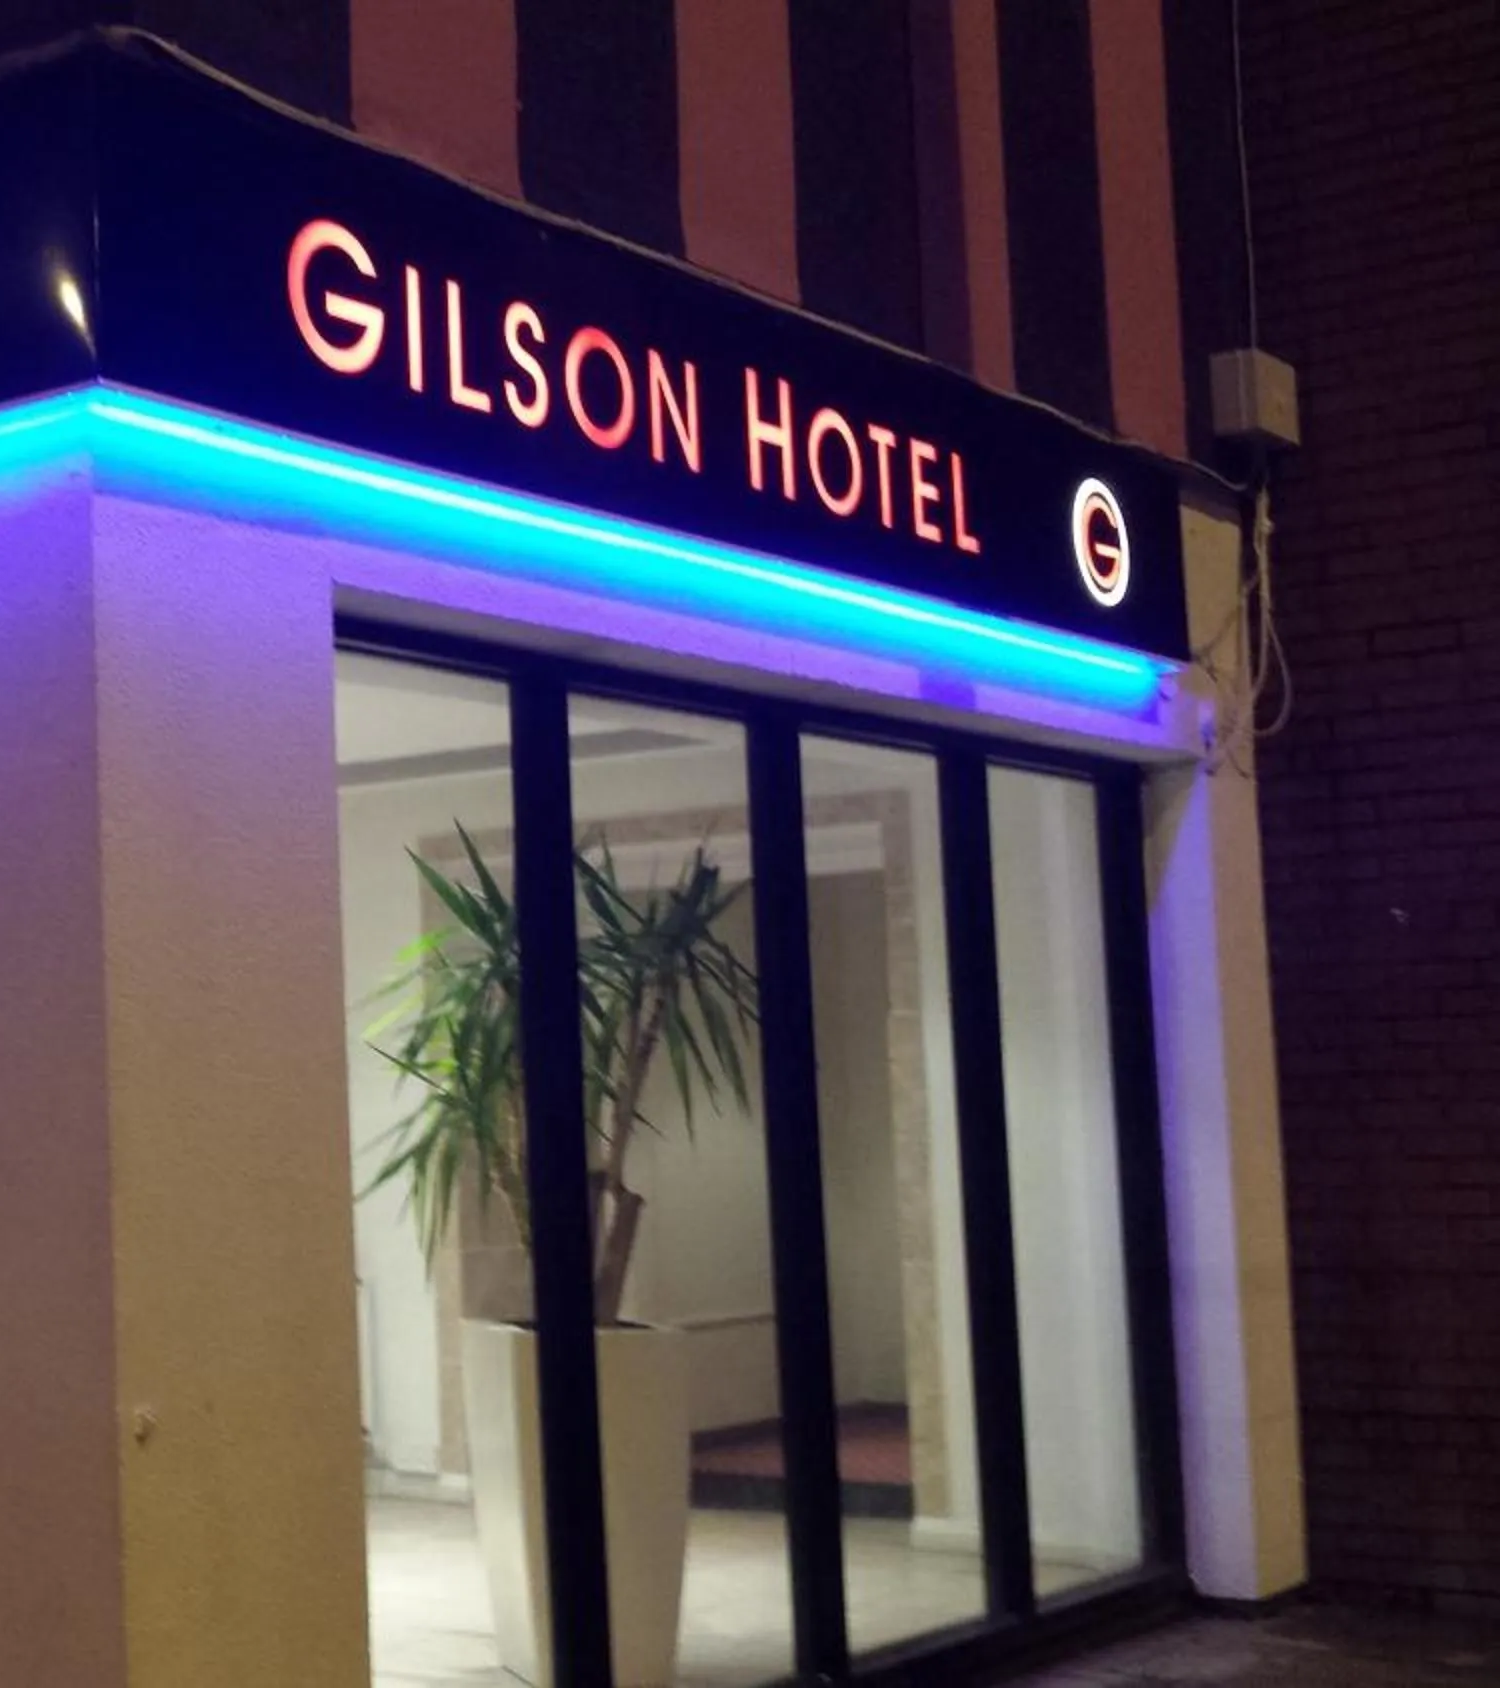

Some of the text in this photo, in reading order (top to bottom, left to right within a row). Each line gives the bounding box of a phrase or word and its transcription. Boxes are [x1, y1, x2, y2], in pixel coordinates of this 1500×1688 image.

[286, 219, 980, 555] GILSON HOTEL
[1079, 493, 1122, 594] G
